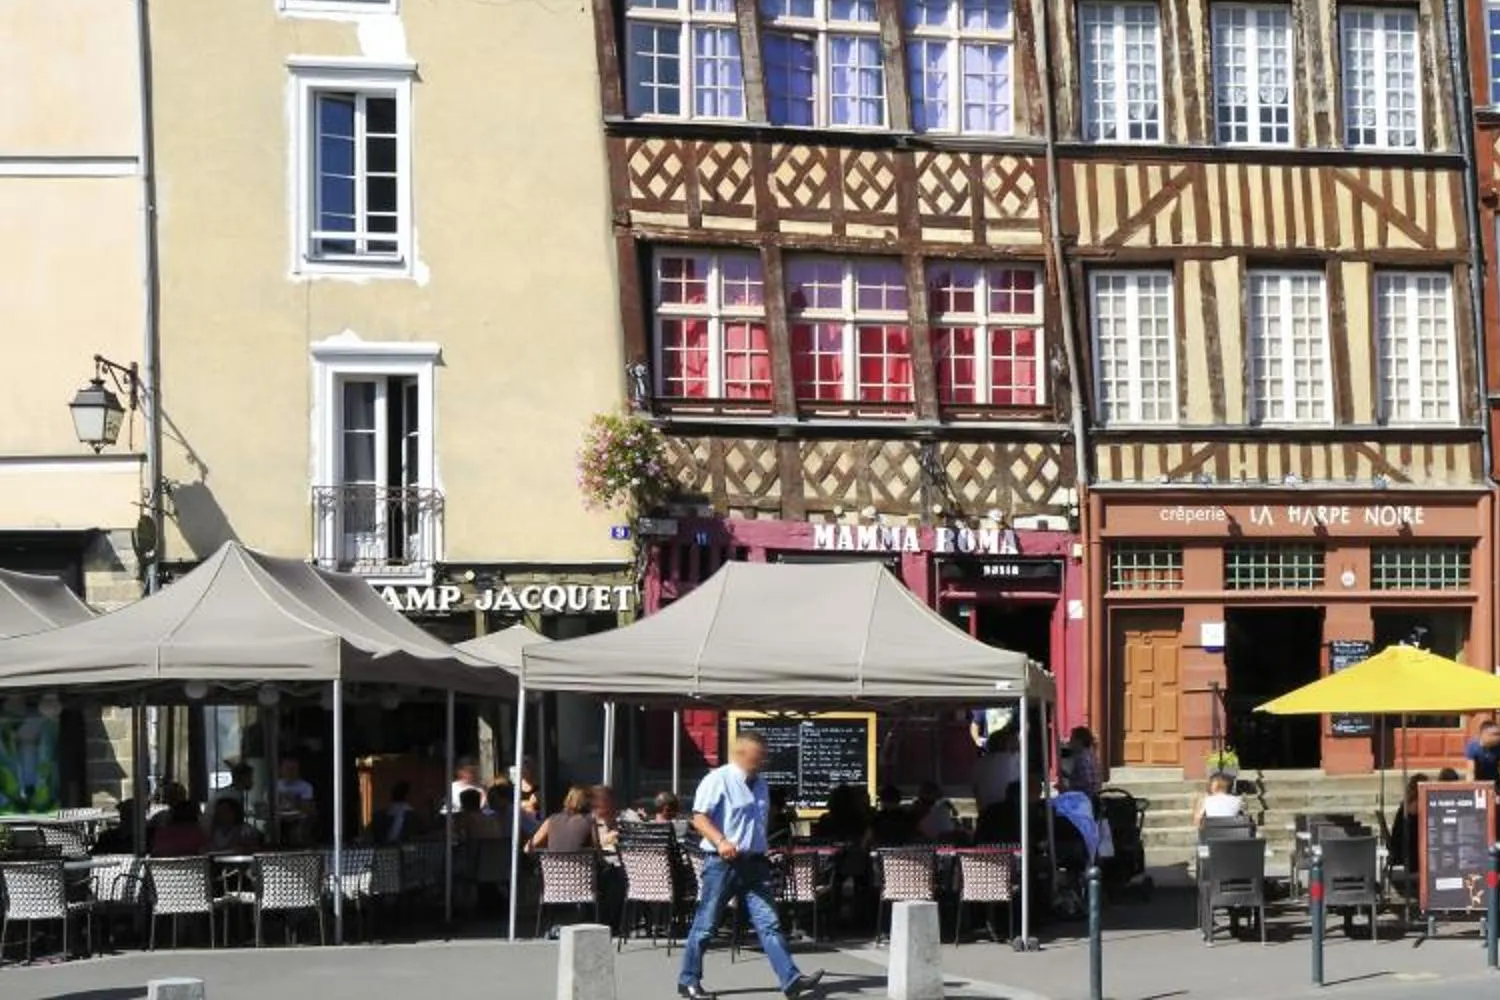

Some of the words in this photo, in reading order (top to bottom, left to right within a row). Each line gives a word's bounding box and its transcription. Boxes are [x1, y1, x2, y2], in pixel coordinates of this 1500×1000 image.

[1160, 505, 1226, 525] crêperie
[1249, 505, 1274, 526] LA
[1287, 505, 1352, 526] HARPE
[1364, 505, 1425, 526] NOIRE
[813, 524, 921, 552] MAMMA
[935, 527, 1019, 554] ROMA
[381, 585, 461, 611] AMP
[474, 585, 633, 612] JACQUET
